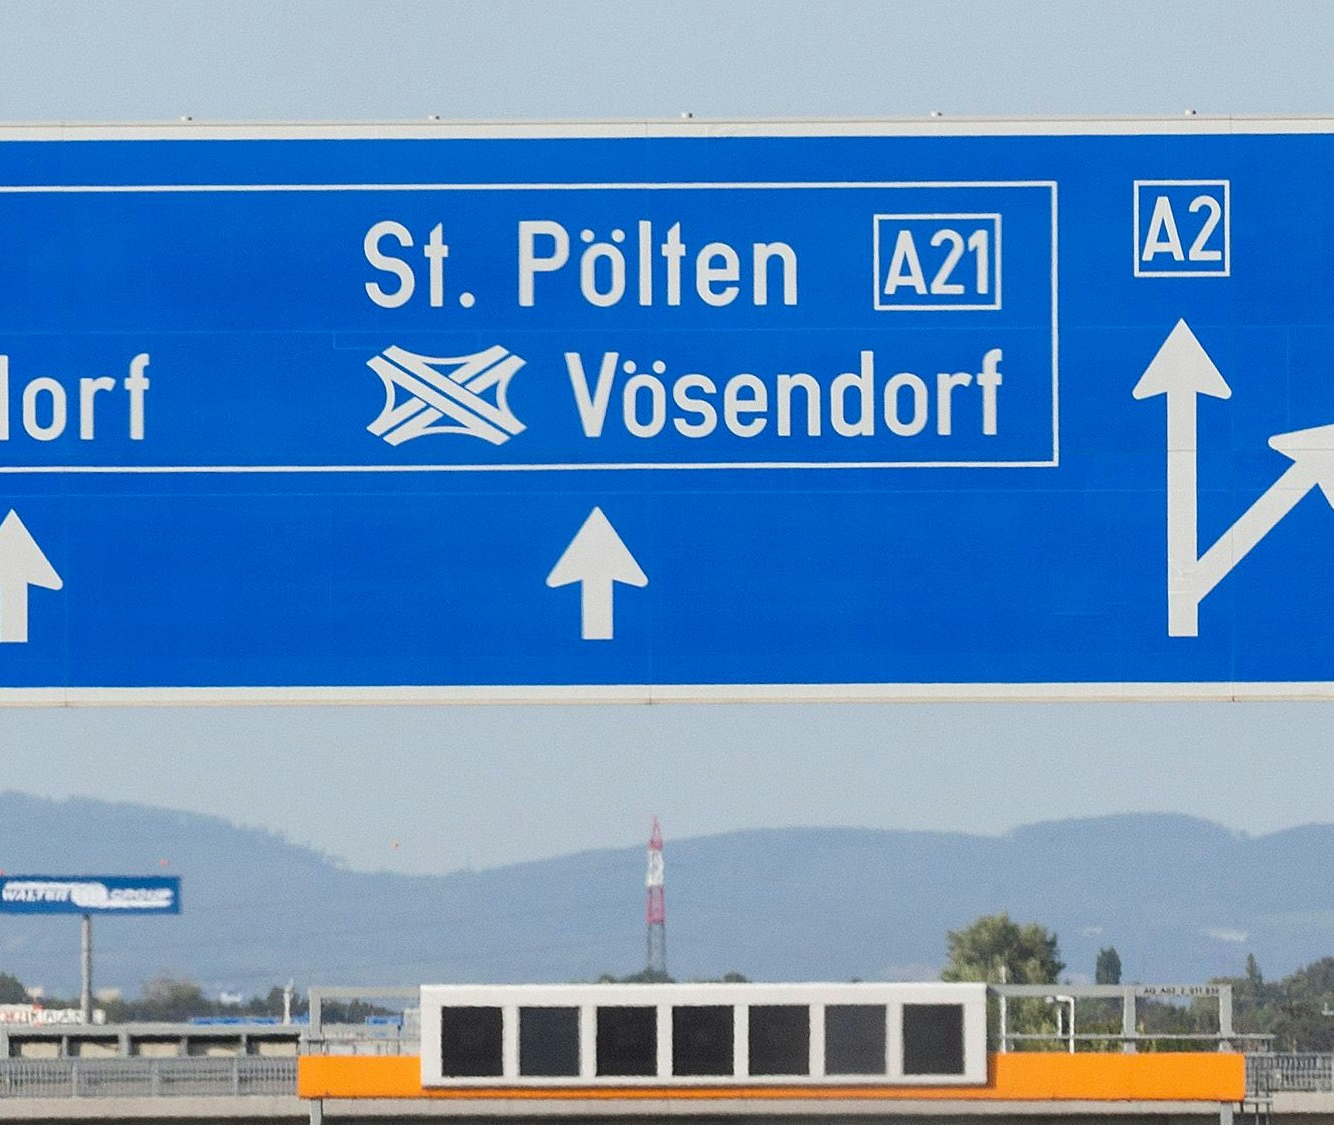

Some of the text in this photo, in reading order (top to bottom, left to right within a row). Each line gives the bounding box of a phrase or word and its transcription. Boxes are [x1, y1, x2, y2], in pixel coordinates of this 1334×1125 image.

[363, 220, 798, 309] St. Pölten
[884, 228, 989, 295] A21
[1141, 195, 1222, 262] A2
[564, 348, 1003, 438] Vösendorf
